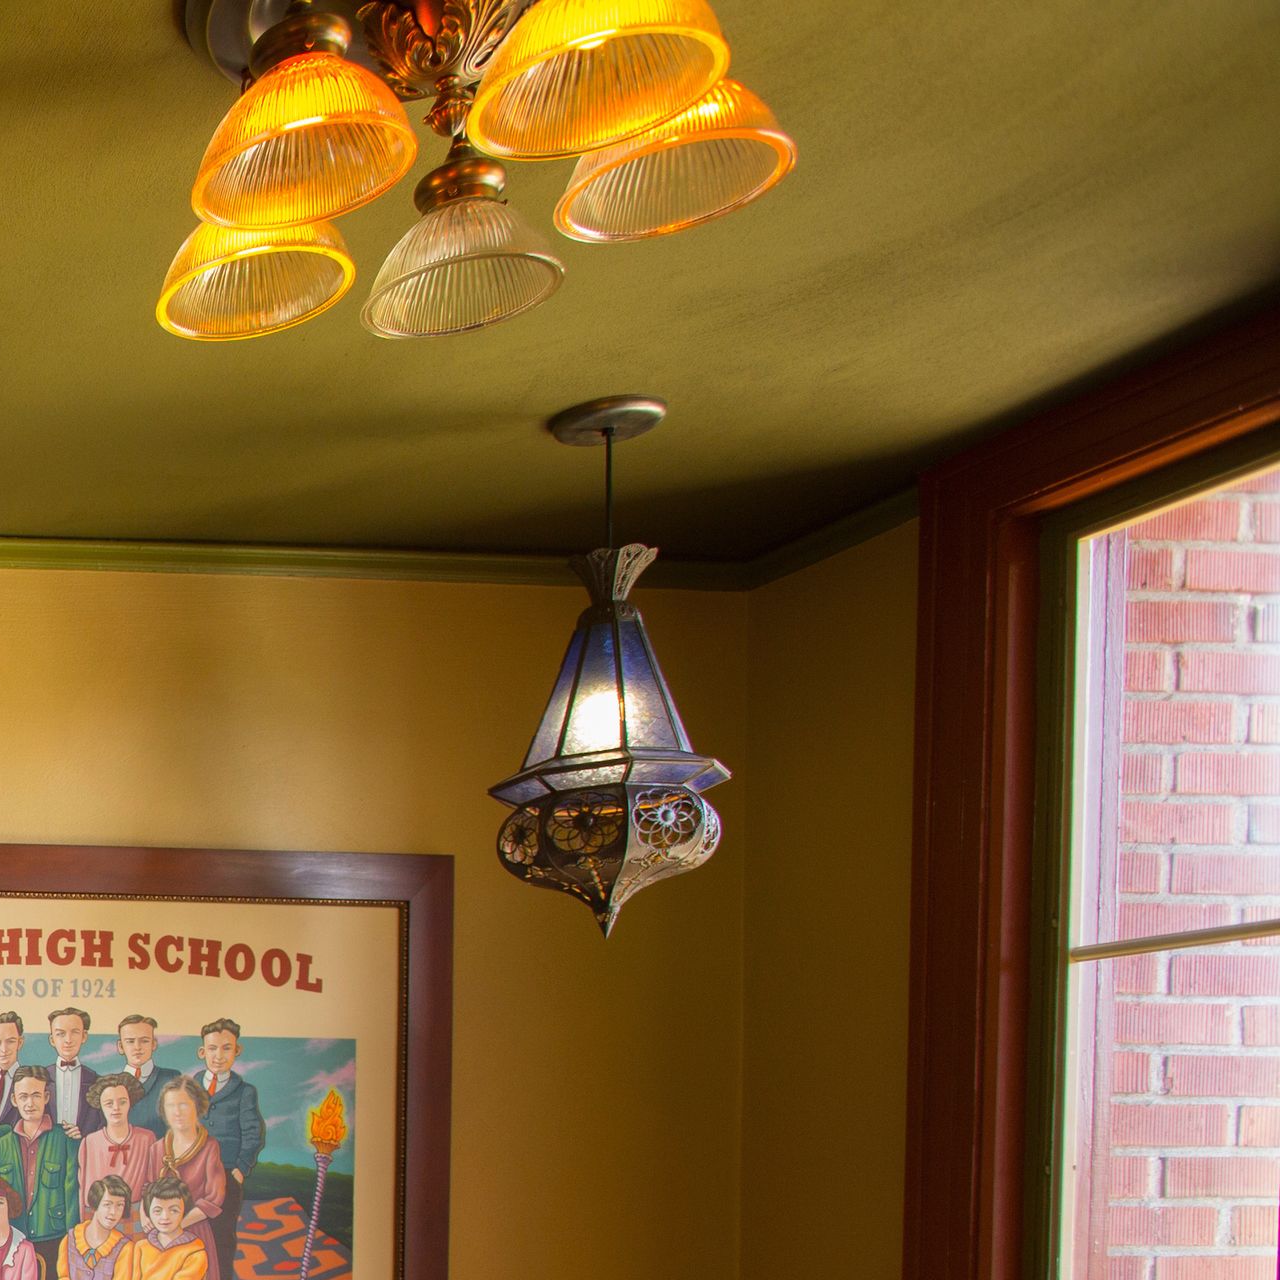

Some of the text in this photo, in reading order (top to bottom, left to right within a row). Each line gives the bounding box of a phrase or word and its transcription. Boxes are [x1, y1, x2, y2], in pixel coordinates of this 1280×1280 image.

[128, 932, 323, 993] SCHOOL
[32, 978, 64, 998] OF
[70, 978, 117, 998] 1924
